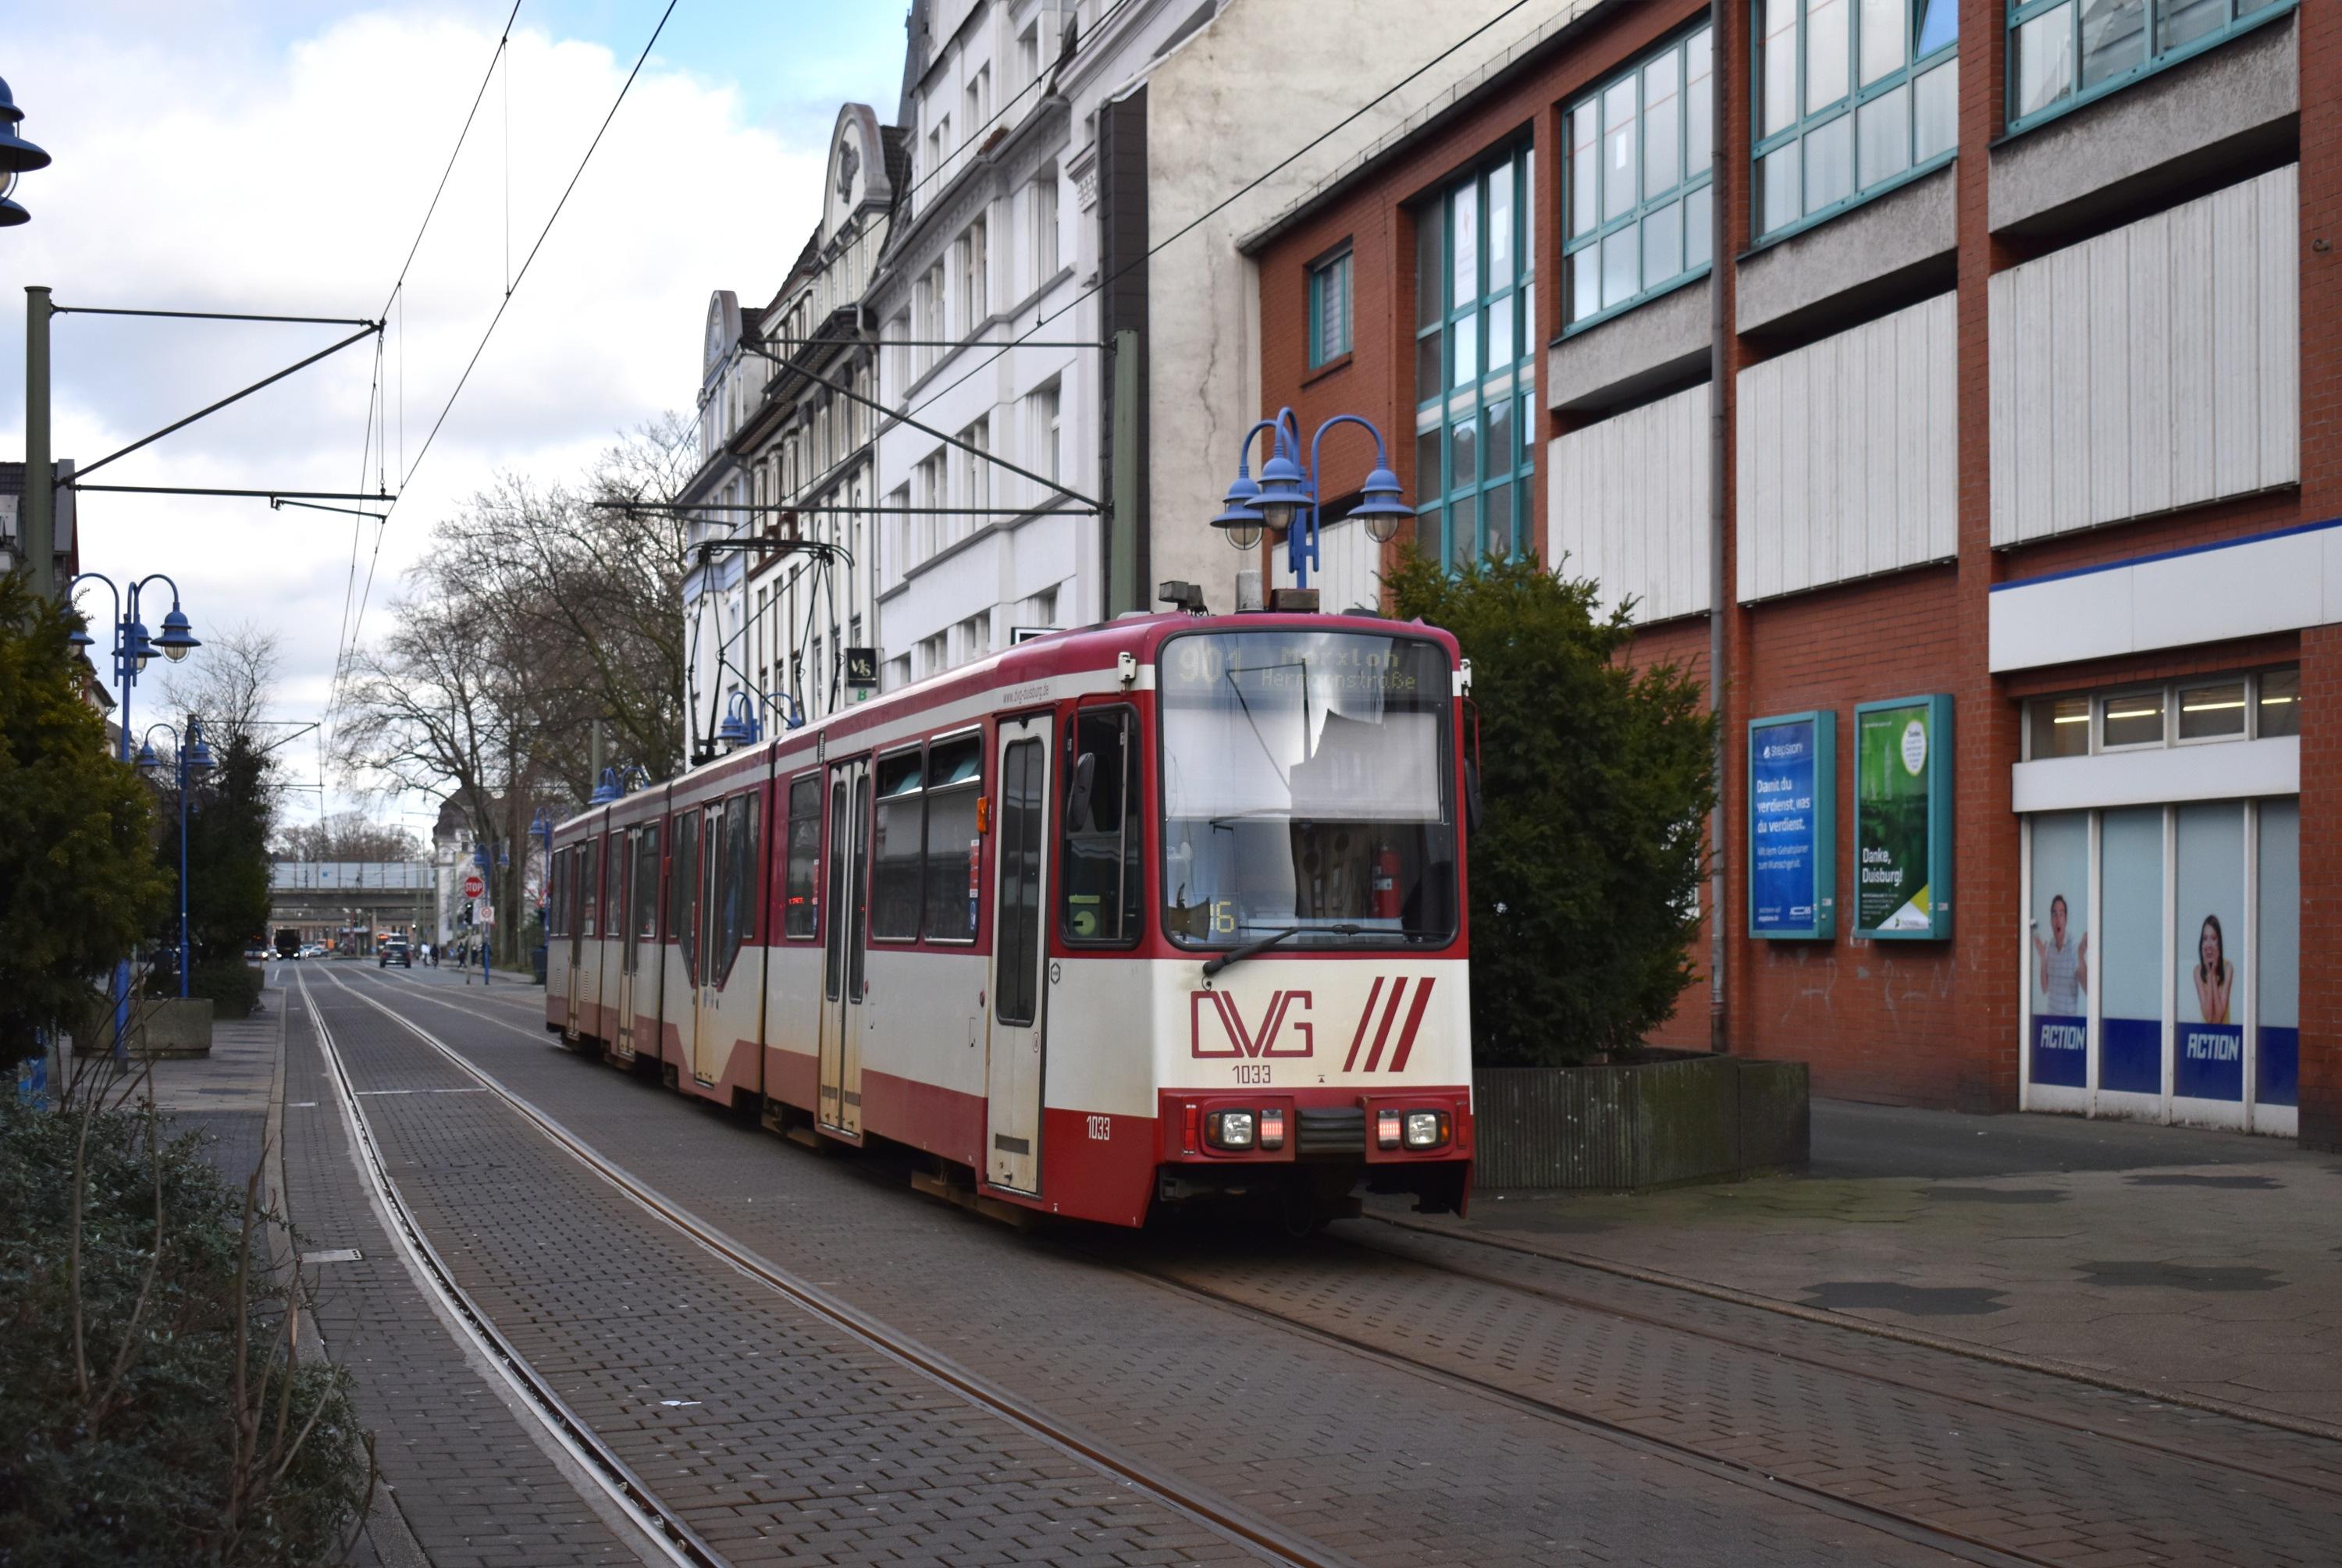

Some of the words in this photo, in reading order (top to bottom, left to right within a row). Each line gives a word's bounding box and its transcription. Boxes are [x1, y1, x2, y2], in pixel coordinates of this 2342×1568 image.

[1179, 647, 1241, 684] 901
[1756, 777, 1780, 793] Damit
[1781, 777, 1792, 791] du
[1757, 819, 1767, 833] du
[1861, 846, 1892, 864] Danke,
[465, 882, 482, 892] STOP
[1861, 867, 1903, 887] Duisburg!
[1191, 990, 1313, 1058] DVG
[2040, 1024, 2087, 1051] ACTION
[2187, 1033, 2240, 1061] ACTION
[1231, 1065, 1271, 1084] 1033
[1086, 1115, 1110, 1140] 1033
